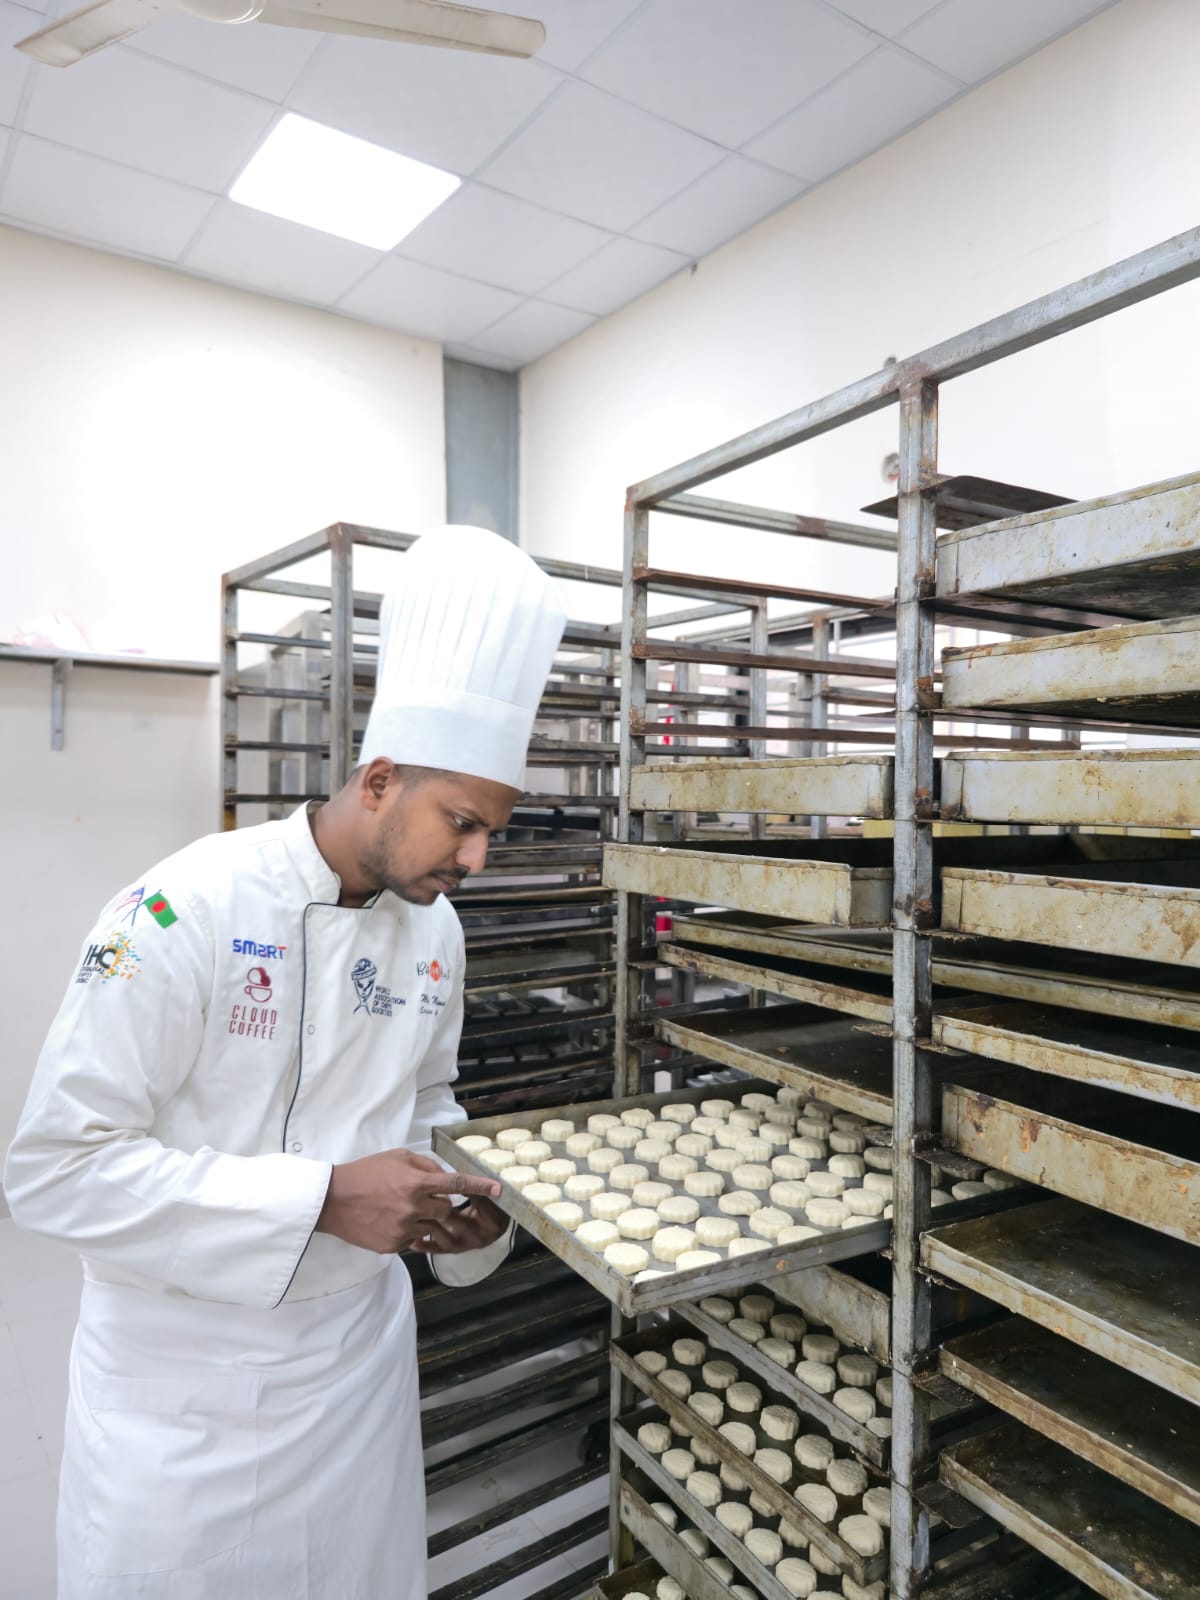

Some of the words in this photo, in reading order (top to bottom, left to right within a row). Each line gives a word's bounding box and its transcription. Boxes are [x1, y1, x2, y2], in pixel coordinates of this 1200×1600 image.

[82, 944, 117, 969] IHC
[231, 1004, 278, 1025] CLOUD
[228, 1019, 276, 1040] COFFEE
